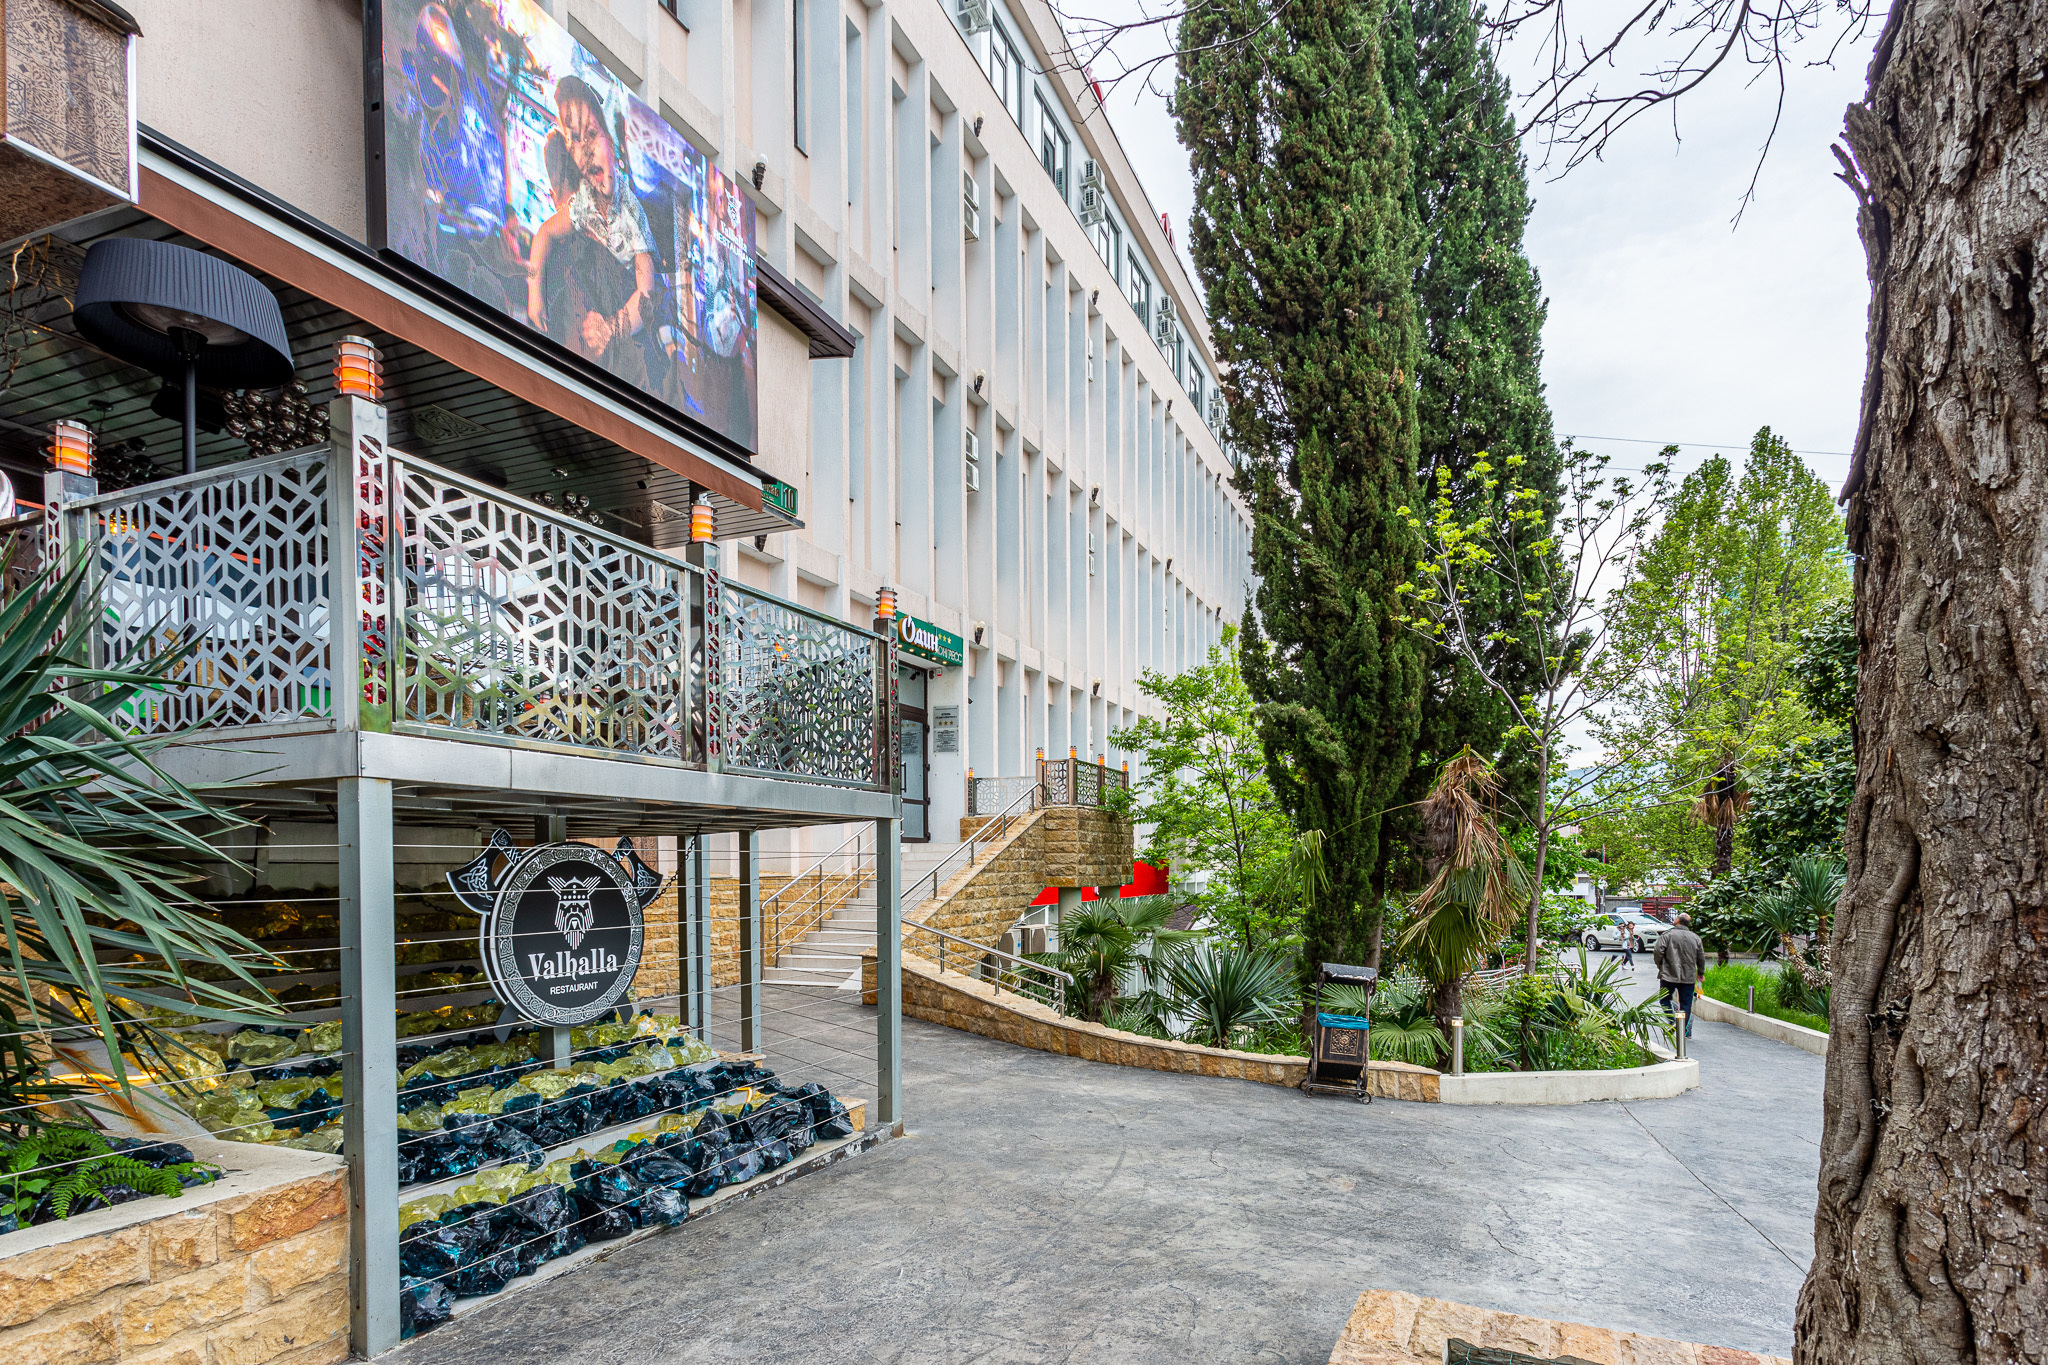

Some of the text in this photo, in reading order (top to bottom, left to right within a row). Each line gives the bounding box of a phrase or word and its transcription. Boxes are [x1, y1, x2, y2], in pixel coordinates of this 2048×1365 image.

[713, 228, 755, 268] RESTAURANT
[783, 487, 795, 511] 10
[936, 645, 963, 663] ОНГРЕСС
[527, 947, 619, 982] Valhalla
[549, 981, 599, 996] RESTAURANT
